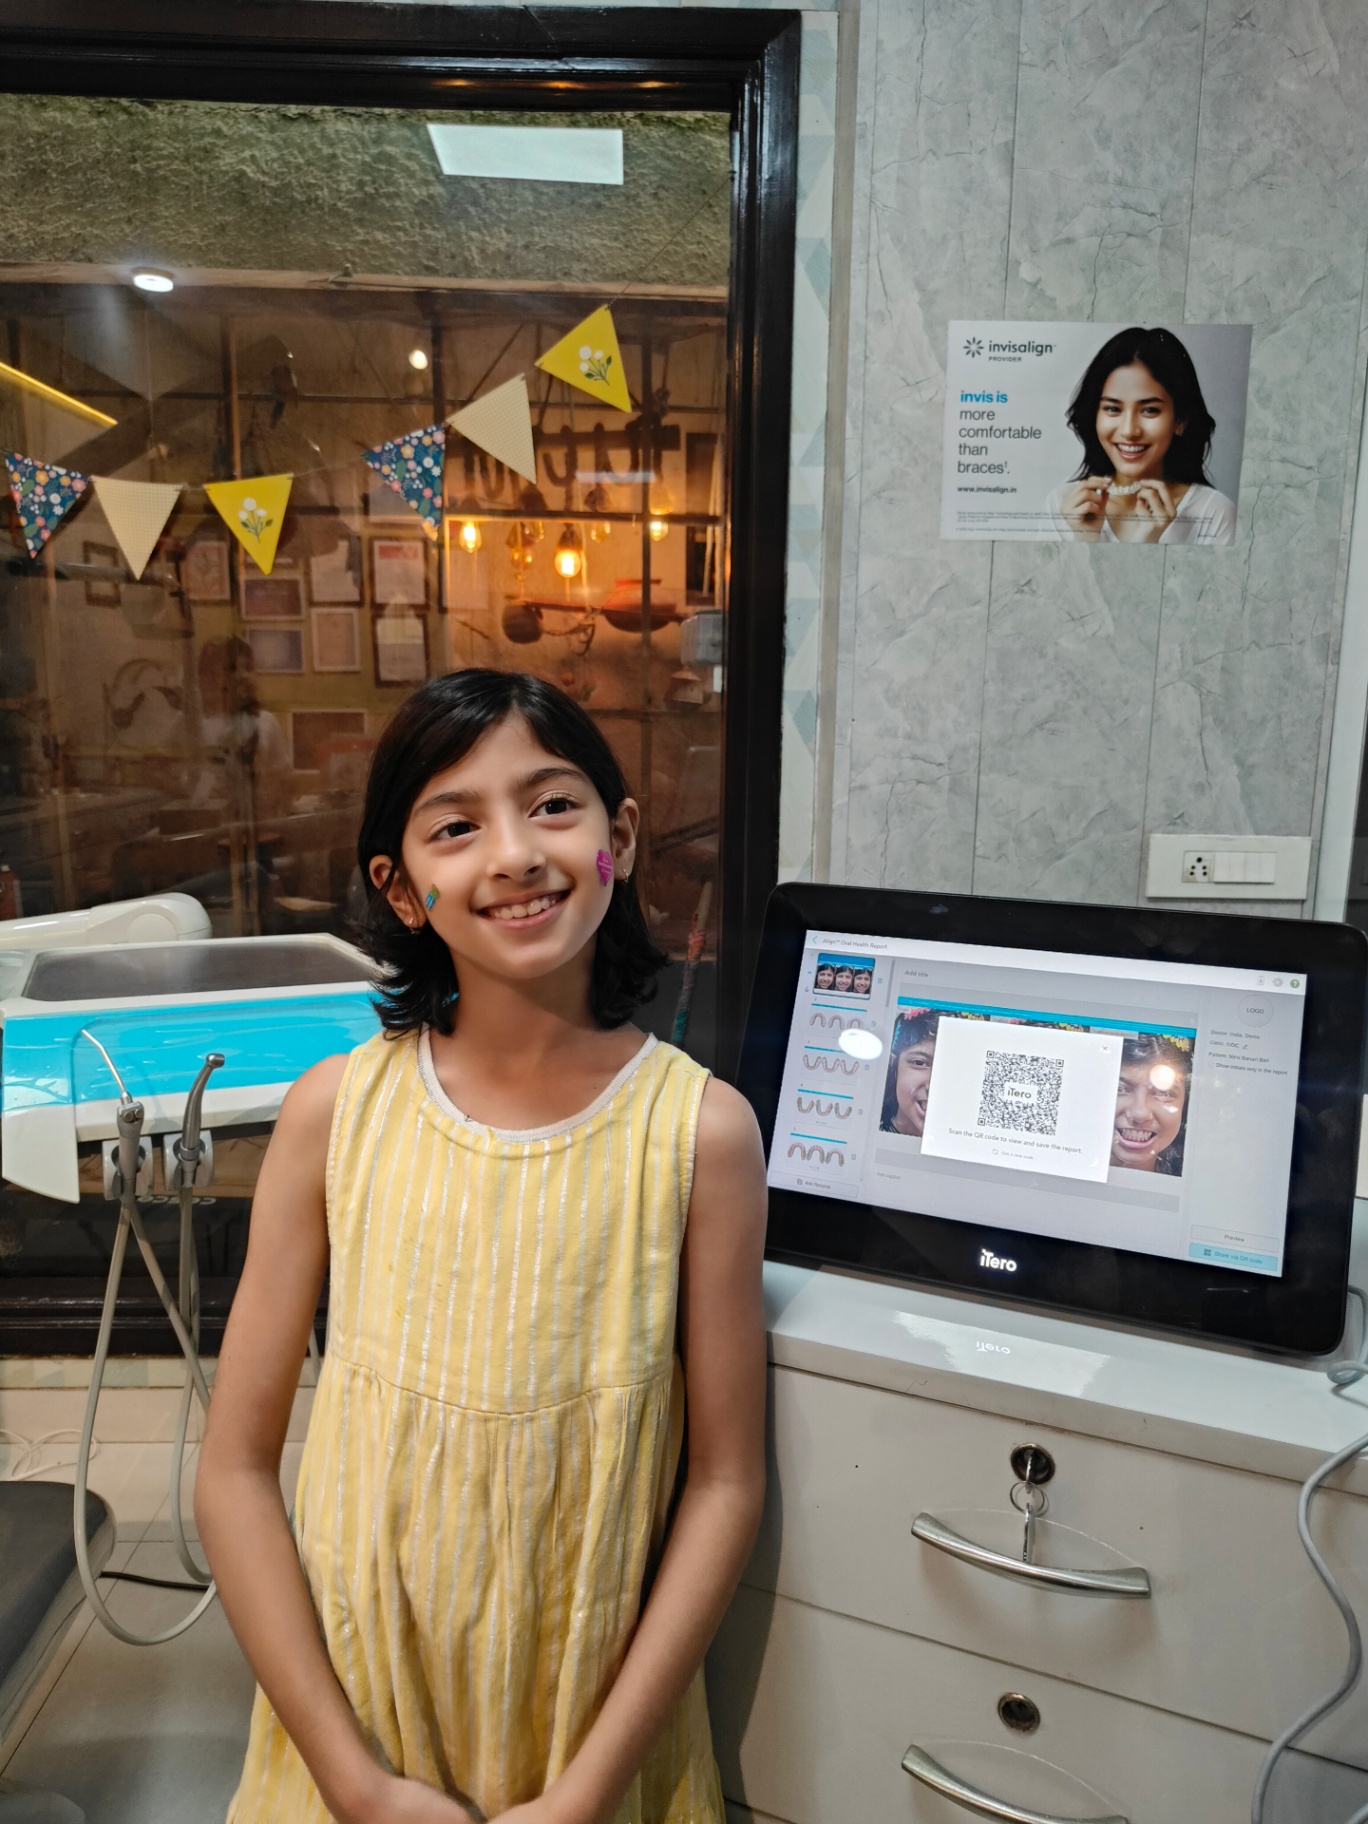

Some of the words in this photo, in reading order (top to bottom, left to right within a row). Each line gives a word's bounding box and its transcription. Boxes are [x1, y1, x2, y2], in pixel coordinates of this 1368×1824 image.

[988, 340, 1053, 356] invisalign
[960, 390, 994, 403] invis
[996, 390, 1008, 403] is
[960, 410, 995, 421] more
[958, 425, 1042, 439] comfortable
[958, 443, 988, 456] than
[957, 486, 1017, 494] www.invisalign.in
[1007, 1086, 1032, 1099] iTero
[948, 1127, 962, 1136] Scan
[963, 1129, 973, 1137] the
[974, 1131, 984, 1139] QR
[984, 1133, 1000, 1141] code
[1008, 1137, 1022, 1145] view
[1023, 1139, 1035, 1147] and
[1062, 1145, 1083, 1154] report.
[1223, 1234, 1245, 1243] Preview
[980, 1248, 1017, 1272] iTero
[1214, 1251, 1230, 1259] Share
[1249, 1257, 1263, 1265] code
